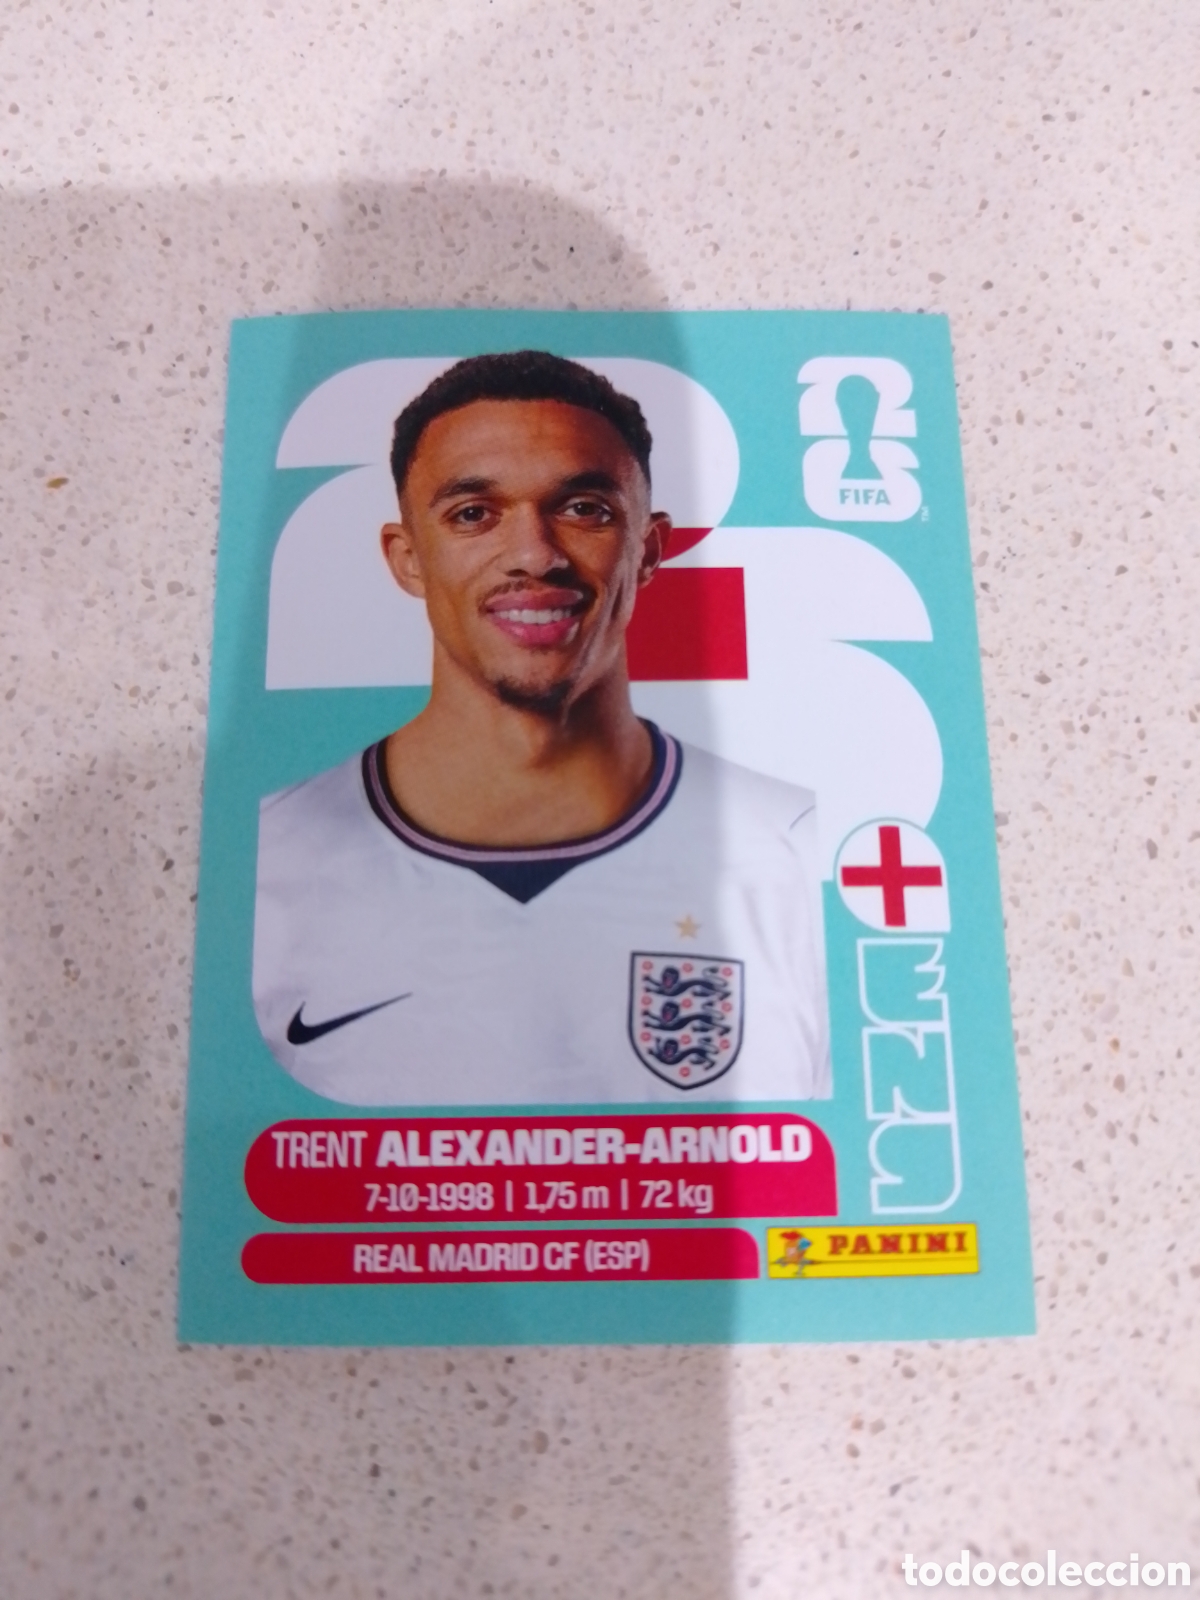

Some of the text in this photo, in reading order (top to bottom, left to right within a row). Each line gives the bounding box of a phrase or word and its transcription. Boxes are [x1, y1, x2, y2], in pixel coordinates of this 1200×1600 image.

[839, 488, 891, 506] FIFA
[271, 1124, 812, 1168] TRENT ALEXANDER-ARNOLD
[364, 1181, 495, 1212] 7-10-1998
[582, 1184, 609, 1209] m
[638, 1179, 673, 1208] 72
[677, 1178, 713, 1214] kg
[353, 1238, 649, 1273] REAL MADRID CF (ESP)
[827, 1231, 968, 1256] PANINI
